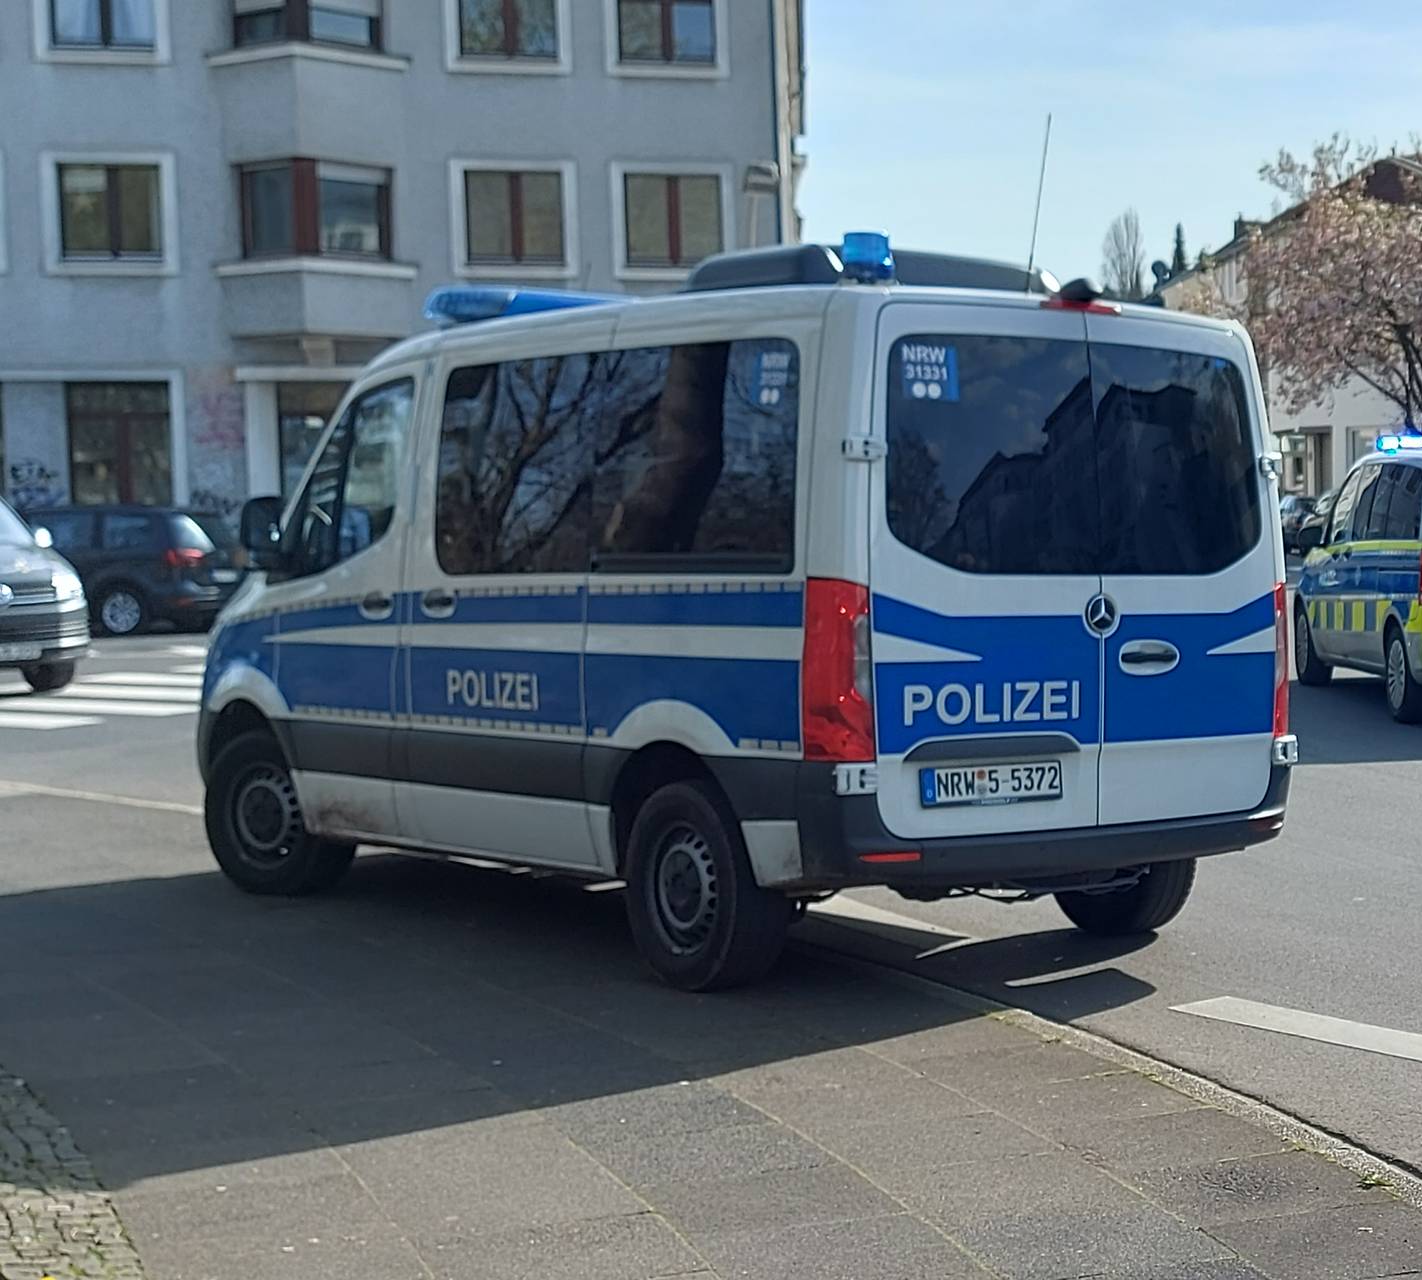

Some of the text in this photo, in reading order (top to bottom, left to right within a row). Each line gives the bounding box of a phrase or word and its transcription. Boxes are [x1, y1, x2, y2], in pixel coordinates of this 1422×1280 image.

[902, 344, 946, 363] NRW
[904, 364, 948, 381] 31331
[446, 668, 539, 712] POLIZEI
[903, 679, 1081, 727] POLIZEI
